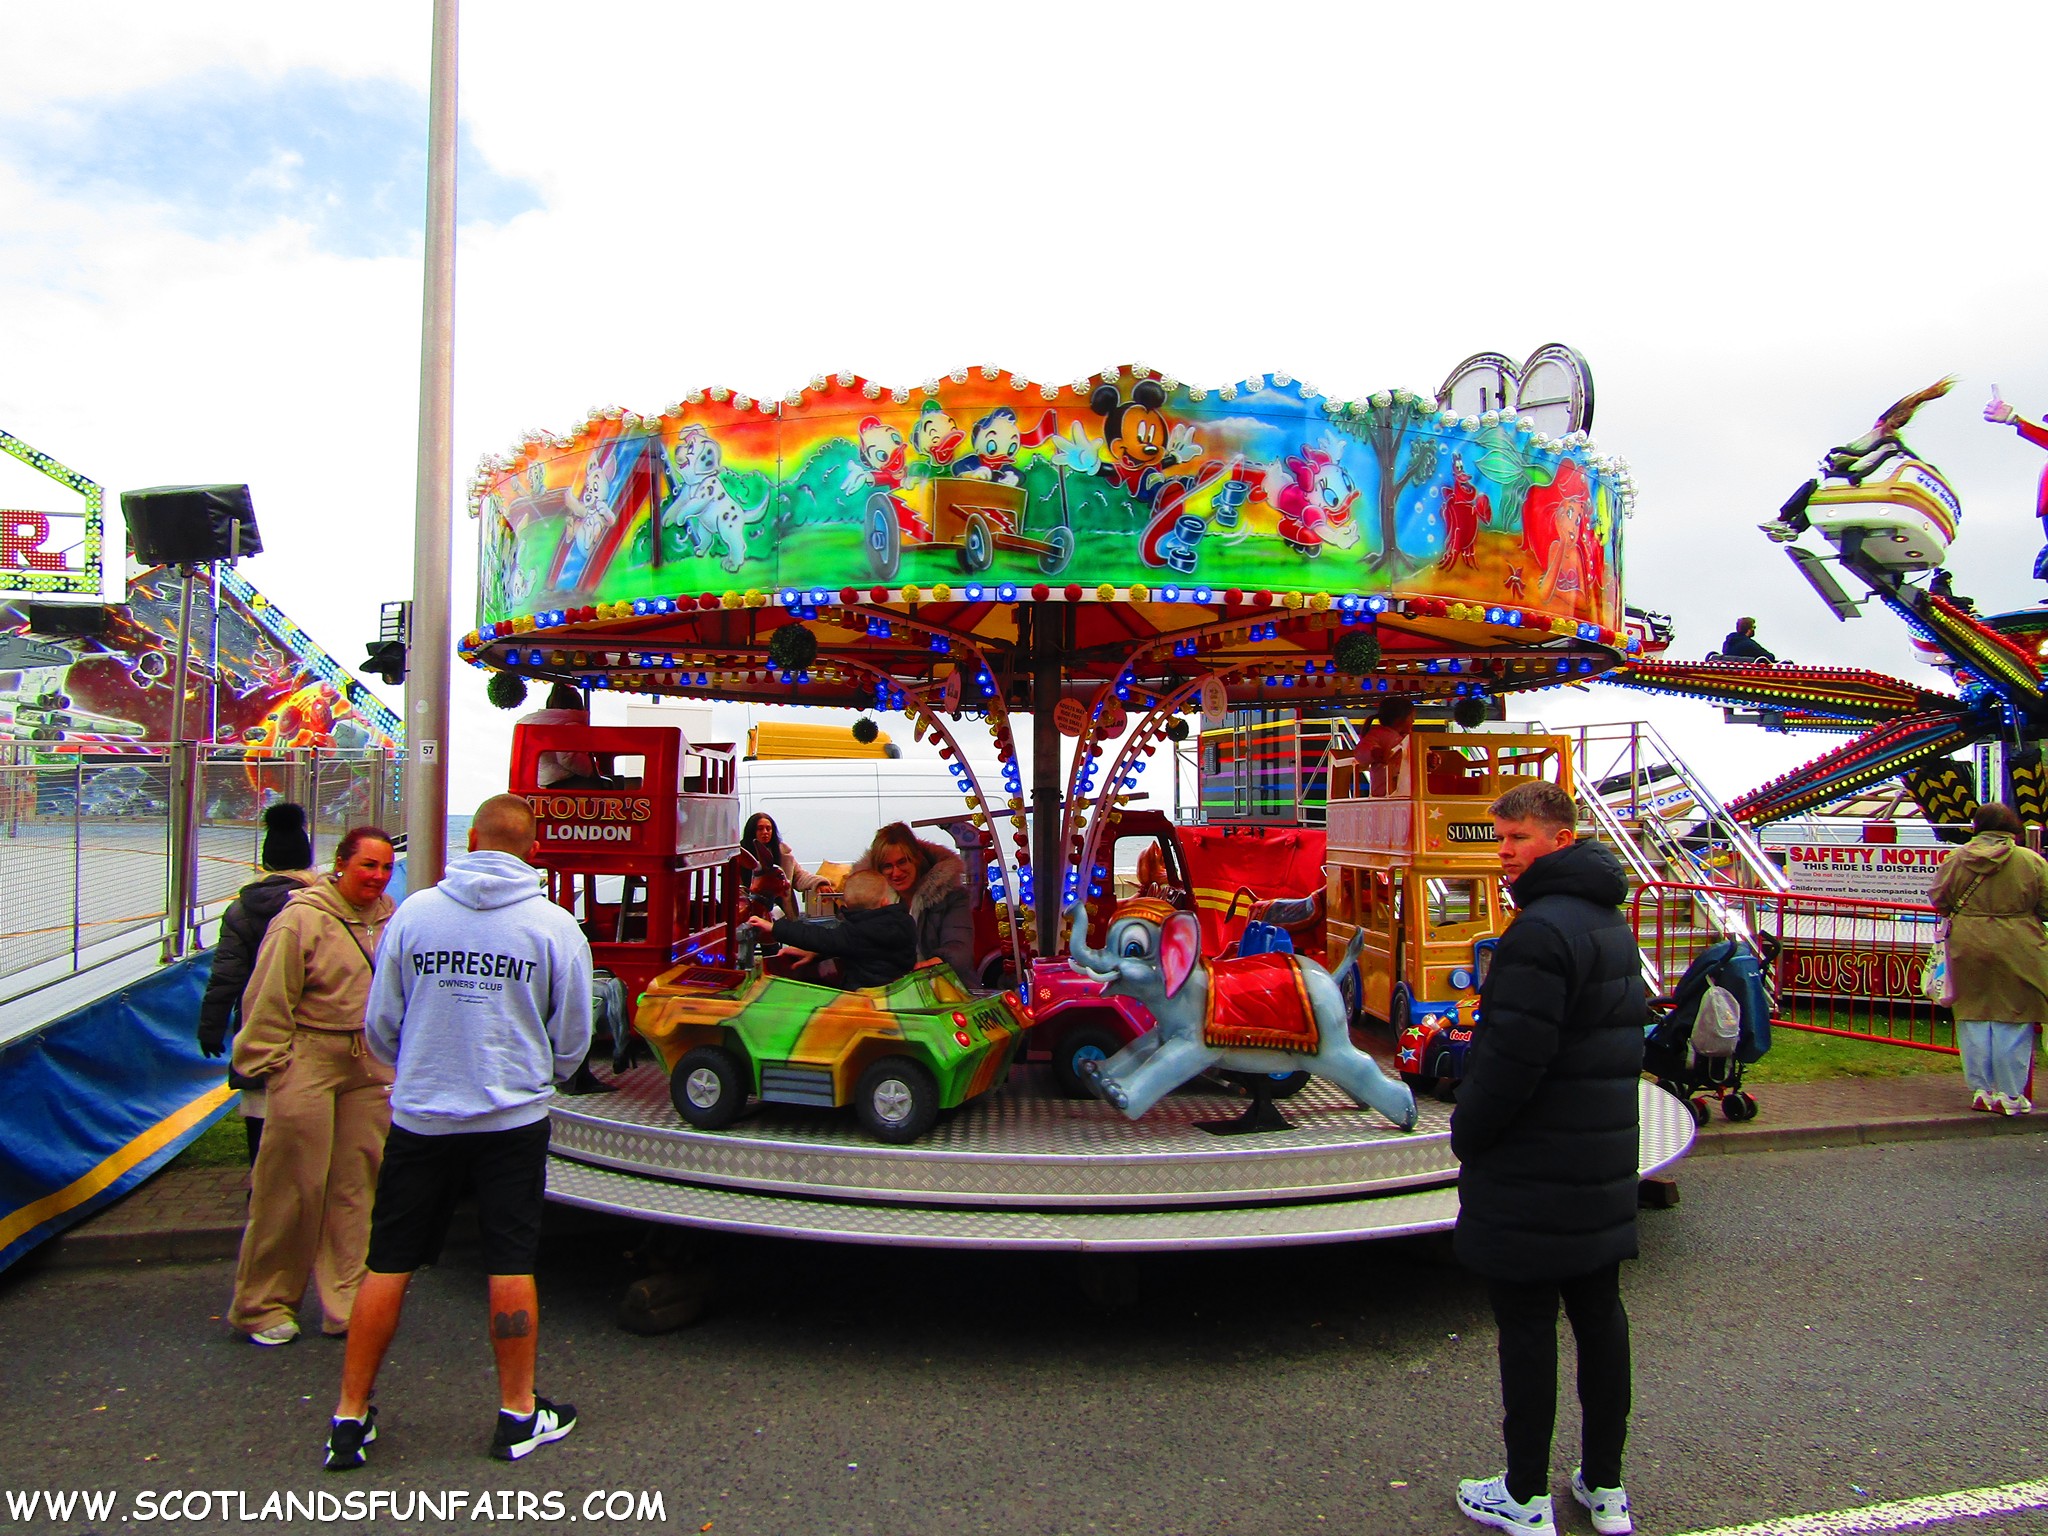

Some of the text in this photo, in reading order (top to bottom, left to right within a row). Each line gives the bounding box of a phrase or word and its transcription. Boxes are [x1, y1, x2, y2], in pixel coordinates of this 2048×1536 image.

[1057, 715, 1068, 723] WITH
[1071, 713, 1082, 721] FREE
[1058, 722, 1080, 733] CHILDREN
[422, 745, 434, 755] 57
[526, 795, 651, 821] TOUR'S
[546, 824, 632, 841] LONDON
[1790, 847, 1874, 863] SAFETY
[1803, 863, 1829, 871] THIS
[1876, 865, 1939, 873] BOISTERO
[412, 950, 537, 983] REPRESENT
[1795, 952, 1879, 996] JUST
[478, 981, 503, 991] CLUB
[972, 1006, 1008, 1032] ARMY
[1450, 1029, 1472, 1042] ford
